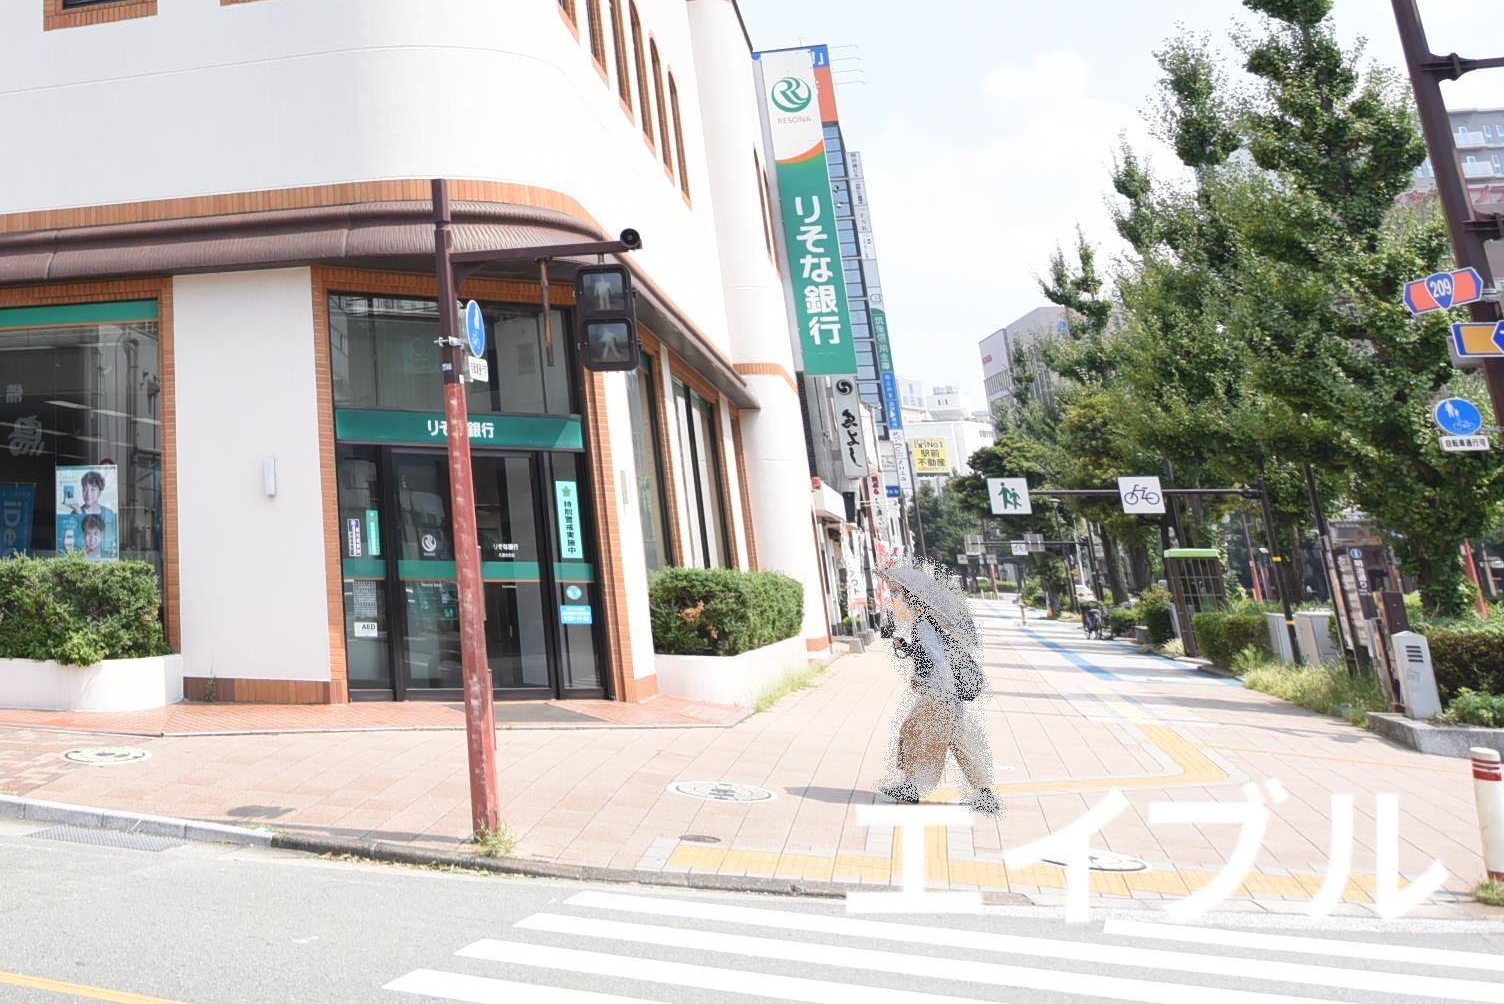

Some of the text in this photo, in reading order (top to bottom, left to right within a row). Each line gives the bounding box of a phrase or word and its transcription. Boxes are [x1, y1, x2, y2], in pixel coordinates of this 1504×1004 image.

[777, 115, 812, 125] RESONA
[794, 195, 841, 346] りそな銀行
[1429, 278, 1452, 298] 209
[427, 419, 494, 438] りそ銀行
[563, 500, 577, 555] 特別警戒実施中
